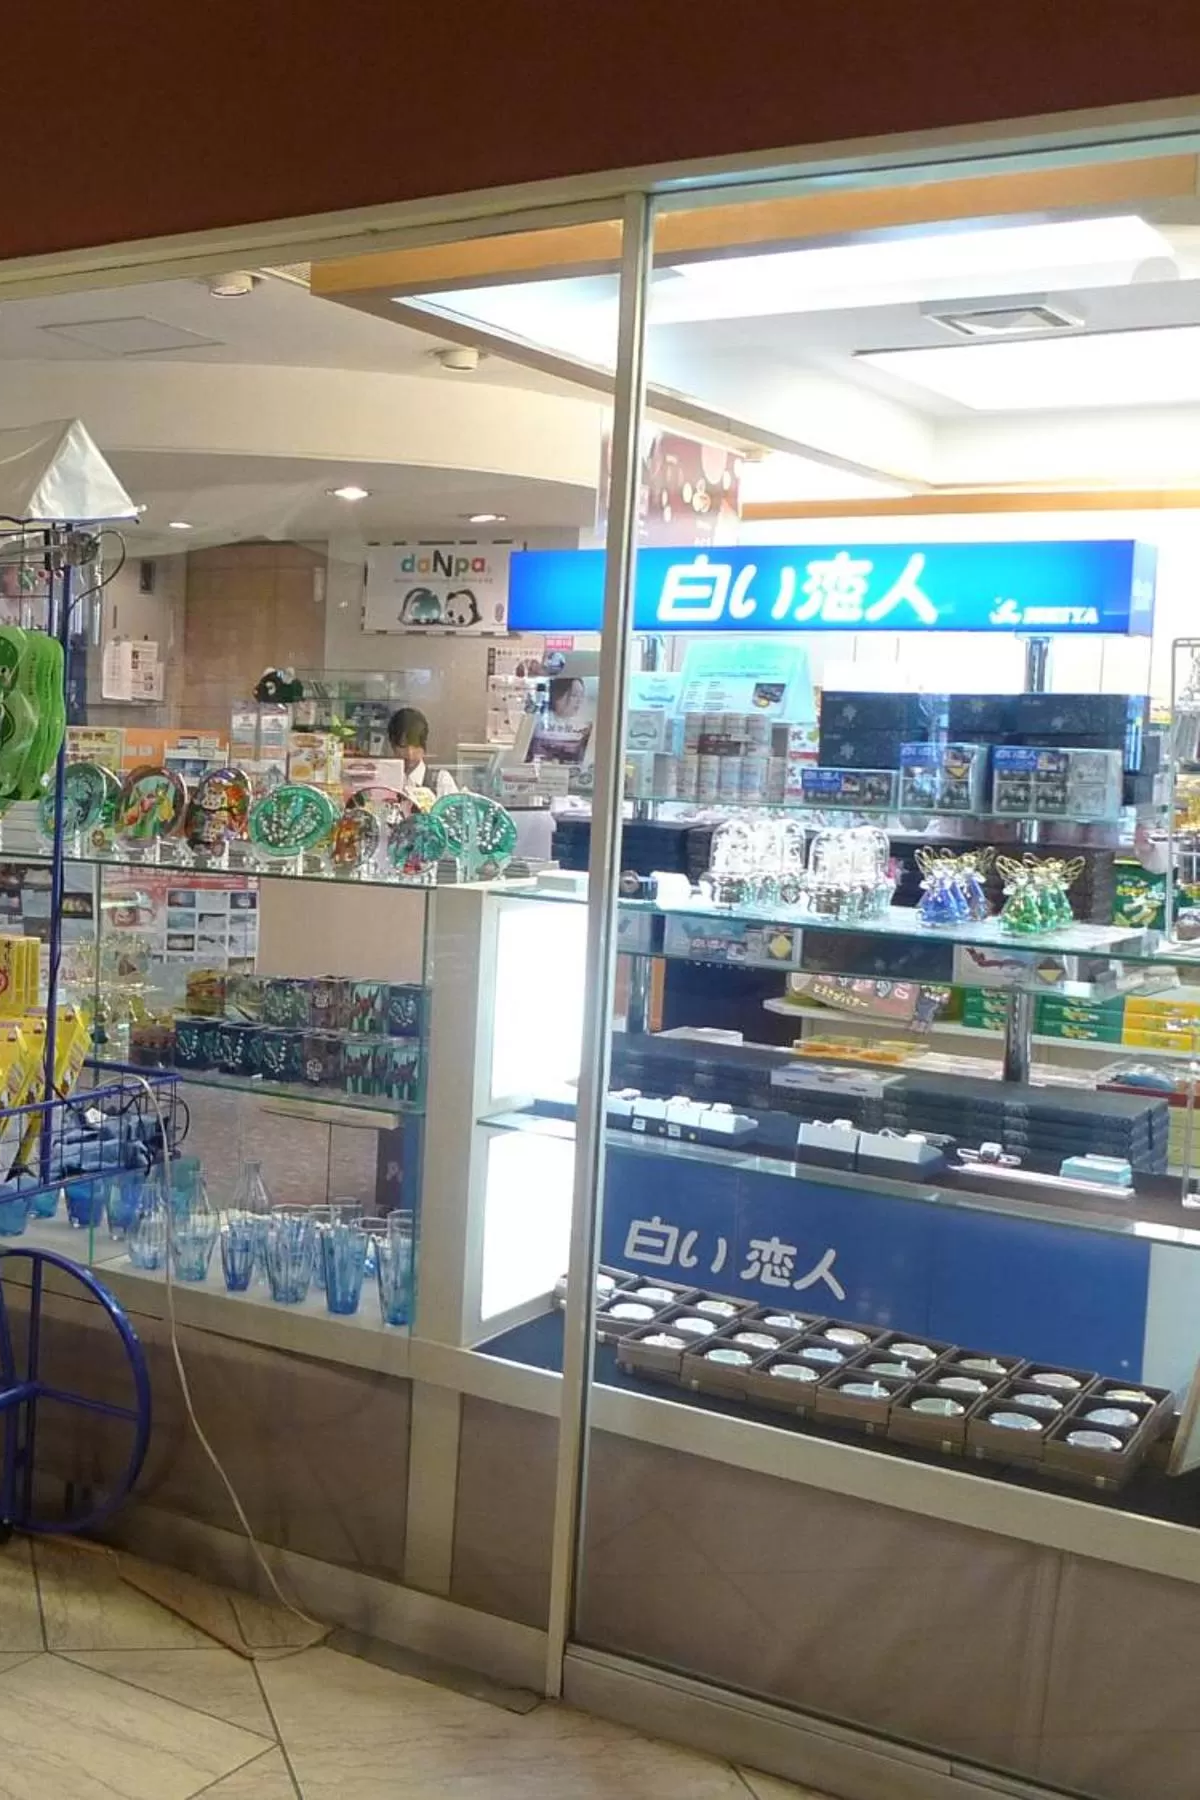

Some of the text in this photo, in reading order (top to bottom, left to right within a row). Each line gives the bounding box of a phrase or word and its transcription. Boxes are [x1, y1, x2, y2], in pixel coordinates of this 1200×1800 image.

[657, 553, 938, 626] 白い恋人
[624, 1215, 846, 1301] 白い恋人
